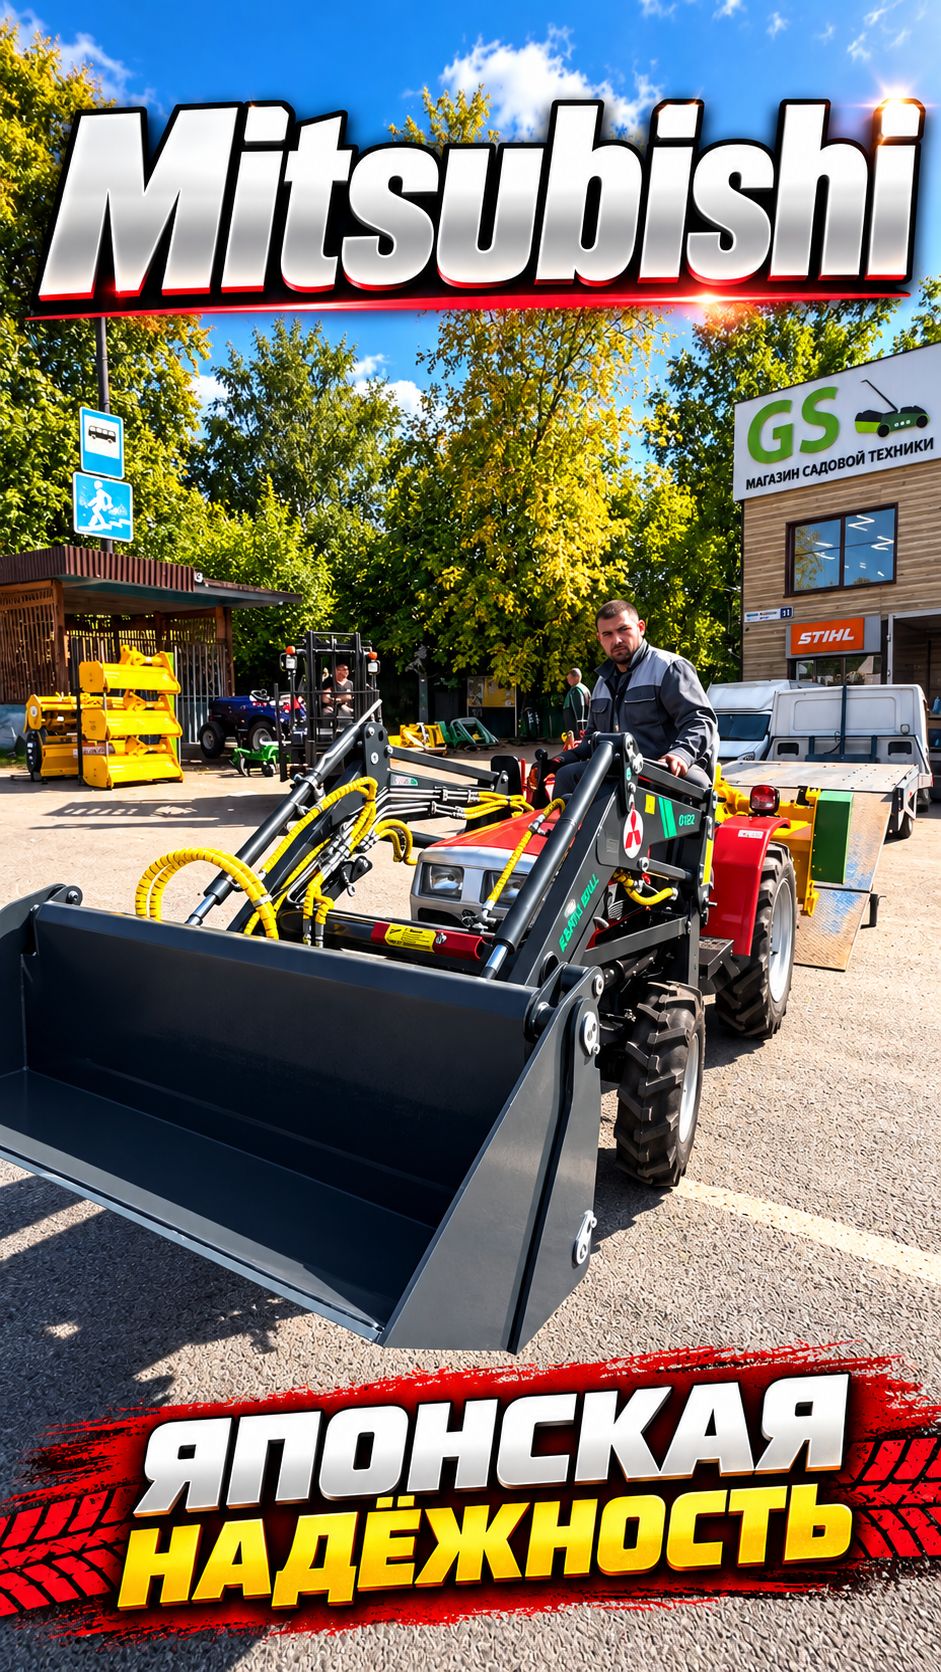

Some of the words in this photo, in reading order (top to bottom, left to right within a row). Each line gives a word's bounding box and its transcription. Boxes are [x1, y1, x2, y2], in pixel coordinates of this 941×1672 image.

[747, 386, 840, 464] GS
[745, 467, 800, 490] МАГАЗИН
[802, 449, 865, 477] САДОВОЙ
[868, 437, 934, 463] ТЕХНИКИ
[797, 627, 855, 646] STIHL
